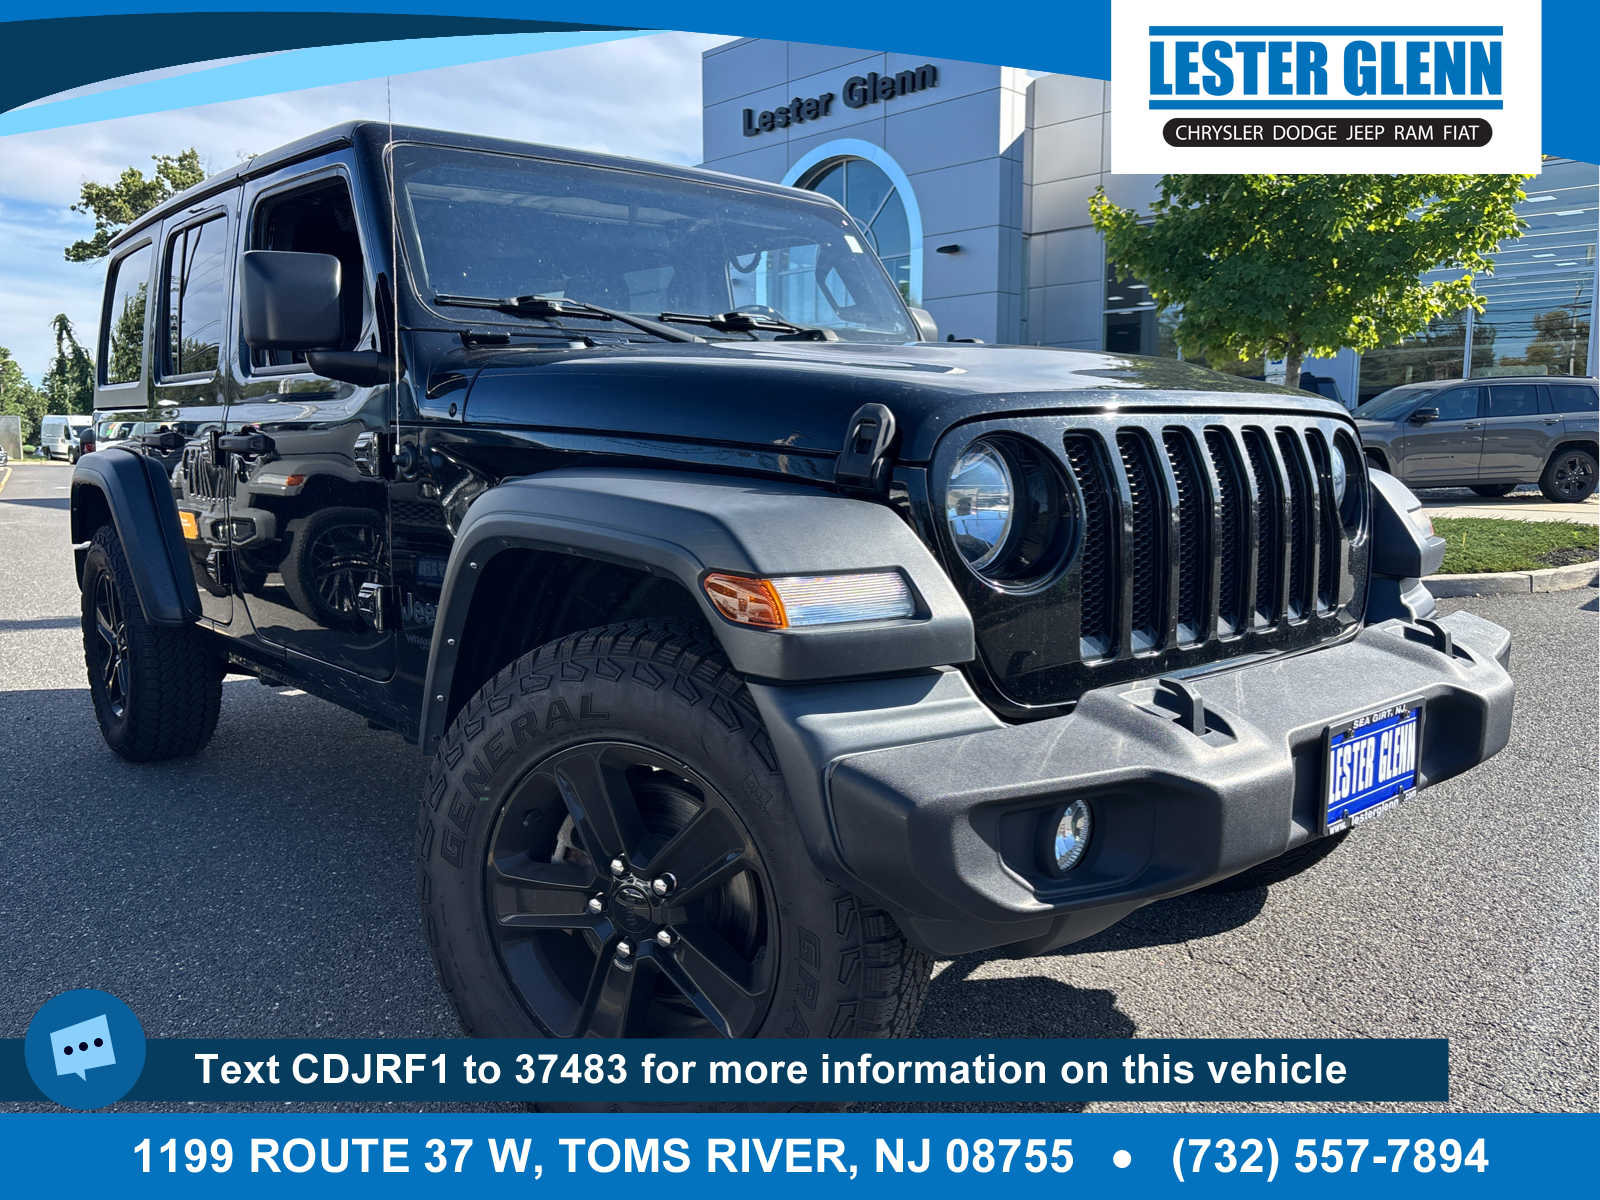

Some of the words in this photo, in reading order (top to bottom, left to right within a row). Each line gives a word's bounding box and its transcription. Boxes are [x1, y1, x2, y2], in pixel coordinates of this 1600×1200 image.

[743, 92, 835, 137] Lester
[843, 64, 937, 109] Glenn
[401, 591, 439, 625] Jee
[1353, 716, 1370, 729] SEA
[441, 695, 609, 868] GENERAL
[1328, 736, 1376, 805] LESTER
[1378, 720, 1416, 783] GLENN
